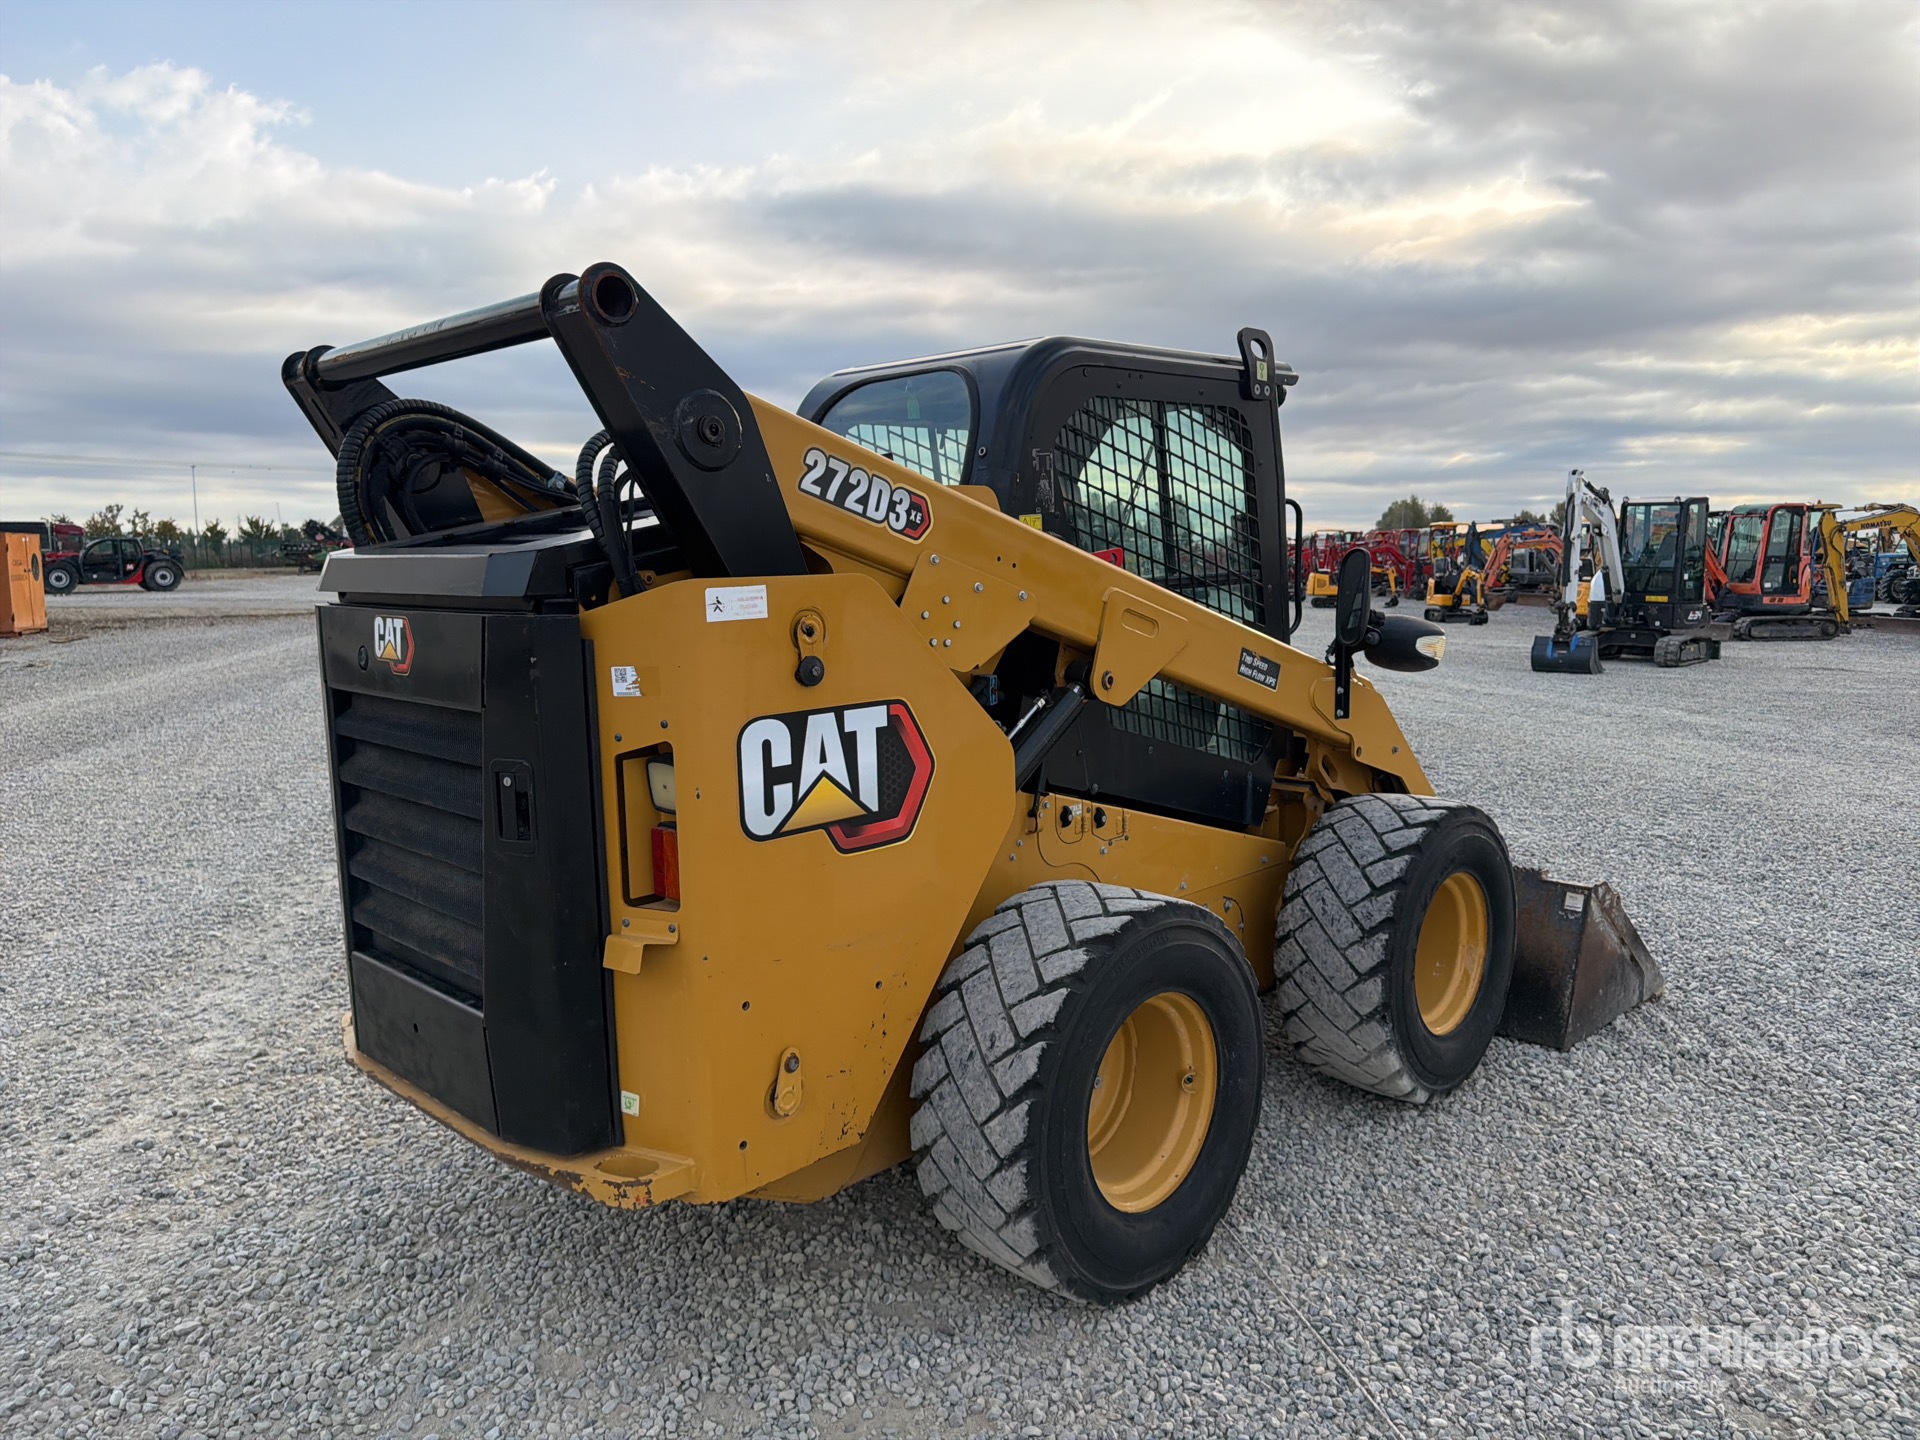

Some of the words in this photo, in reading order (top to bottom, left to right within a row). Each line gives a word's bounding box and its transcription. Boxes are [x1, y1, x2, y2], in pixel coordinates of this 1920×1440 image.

[800, 449, 911, 531] 272D3
[909, 509, 923, 524] XE
[1861, 520, 1892, 529] KOMATSU
[374, 616, 404, 660] CAT
[1265, 675, 1277, 687] XPS
[740, 705, 888, 836] CAT
